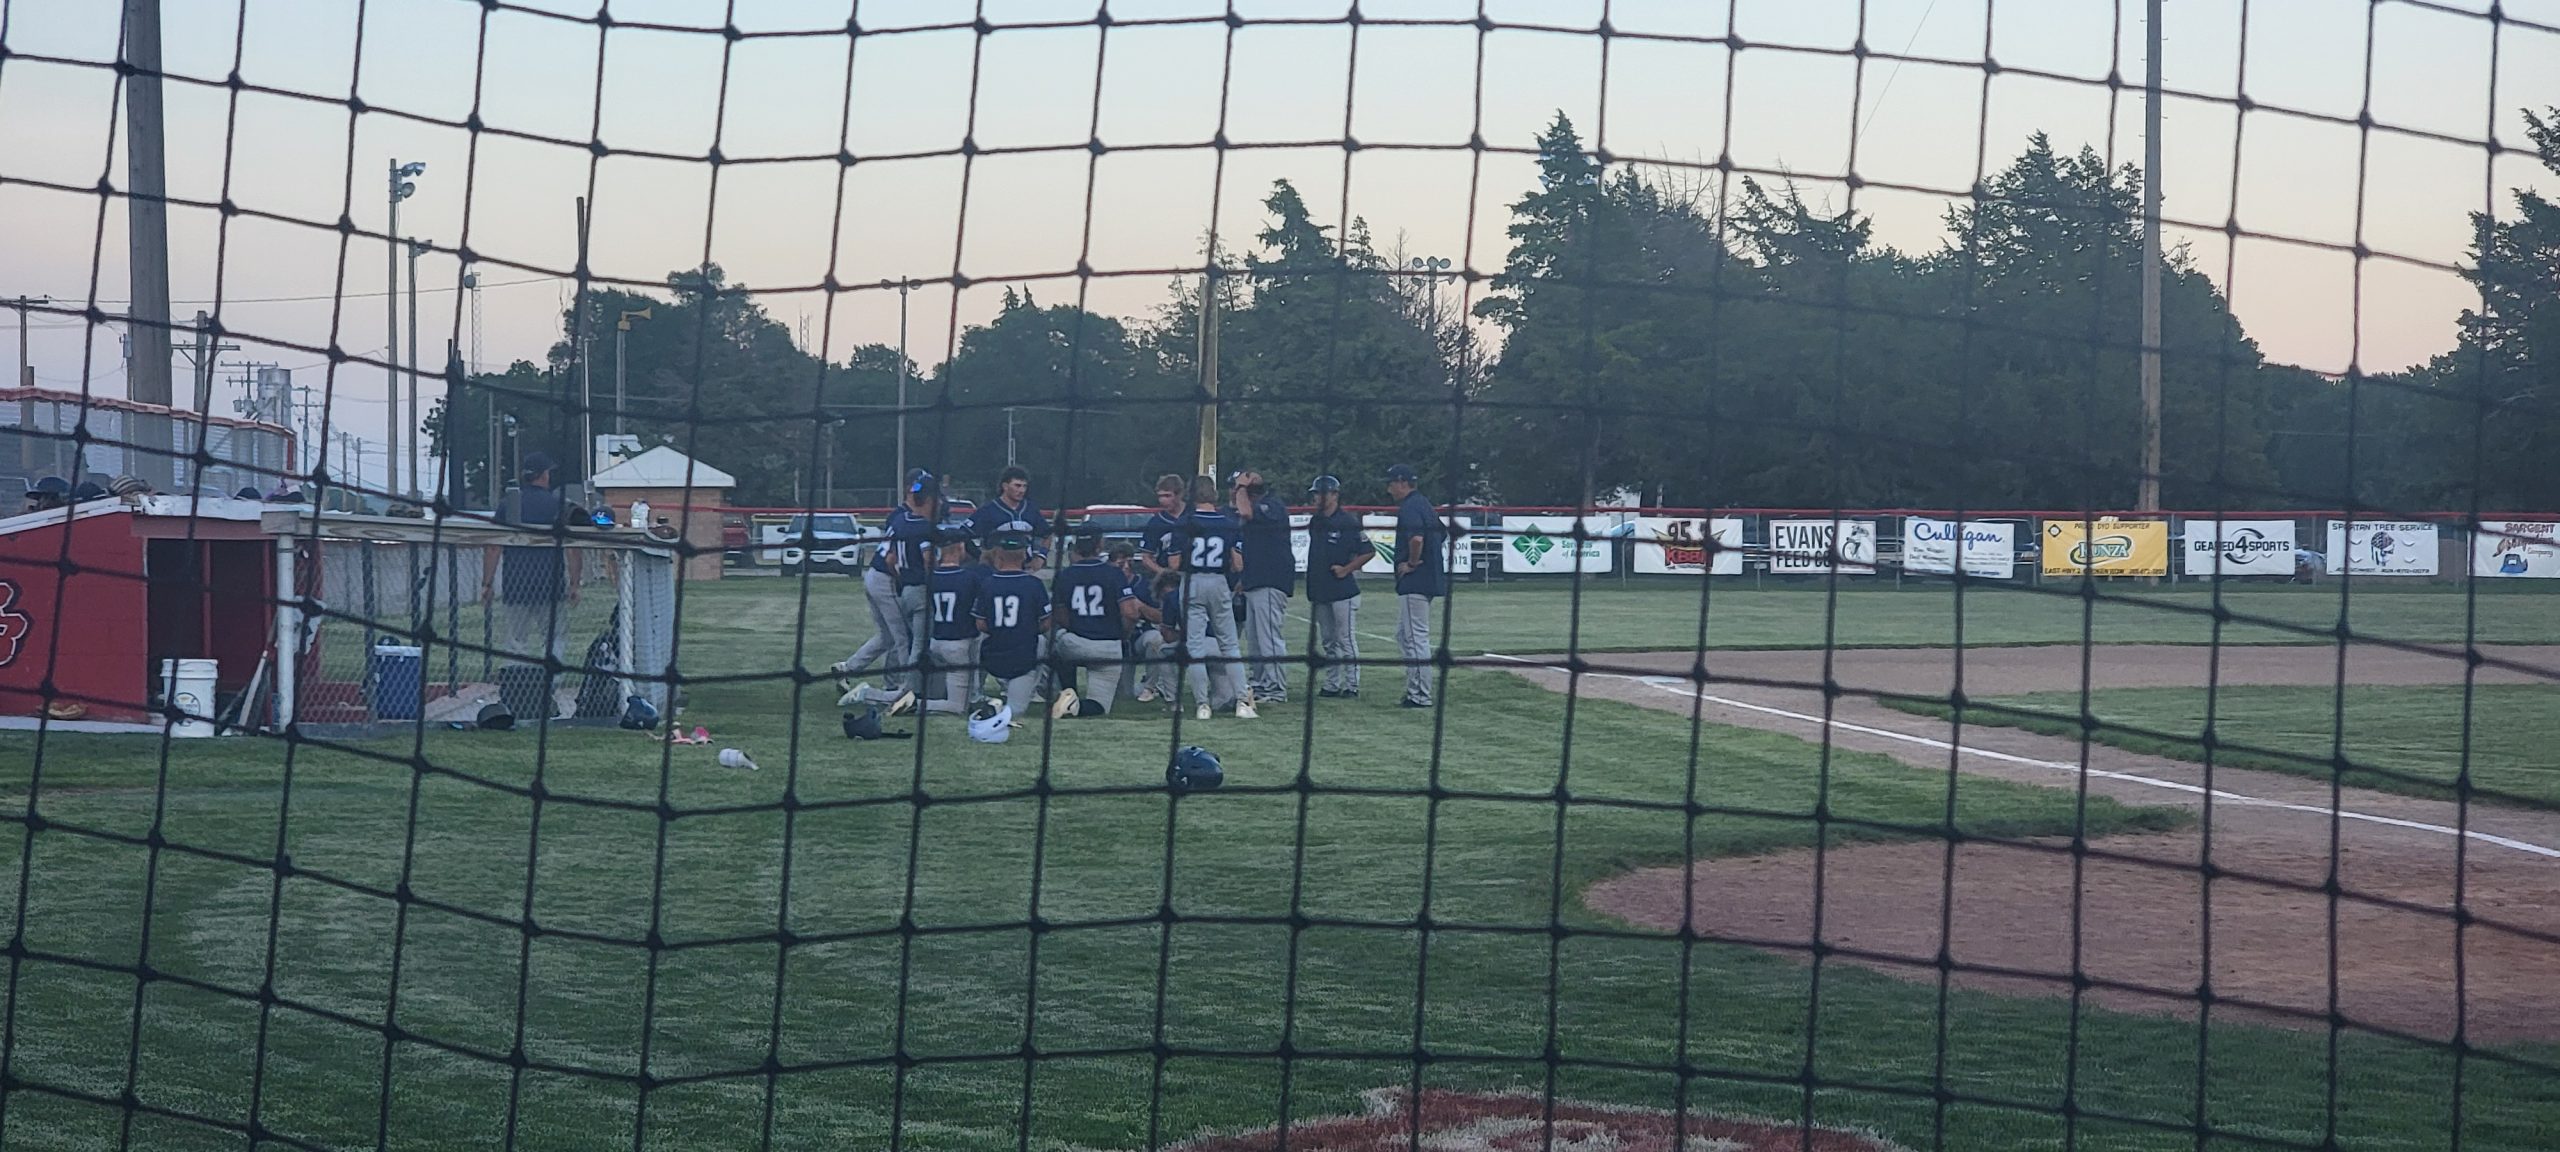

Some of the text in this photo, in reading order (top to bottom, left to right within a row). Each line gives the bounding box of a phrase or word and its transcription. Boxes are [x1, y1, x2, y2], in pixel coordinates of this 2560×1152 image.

[1775, 526, 1834, 549] EVANS
[1914, 522, 2003, 551] Culligan
[2332, 523, 2371, 531] SPRTAN
[2505, 522, 2555, 533] SARGENT
[1190, 536, 1224, 567] 22
[1777, 551, 1810, 567] FEED
[933, 592, 956, 622] 17
[994, 595, 1019, 628] 13
[1071, 585, 1105, 616] 42
